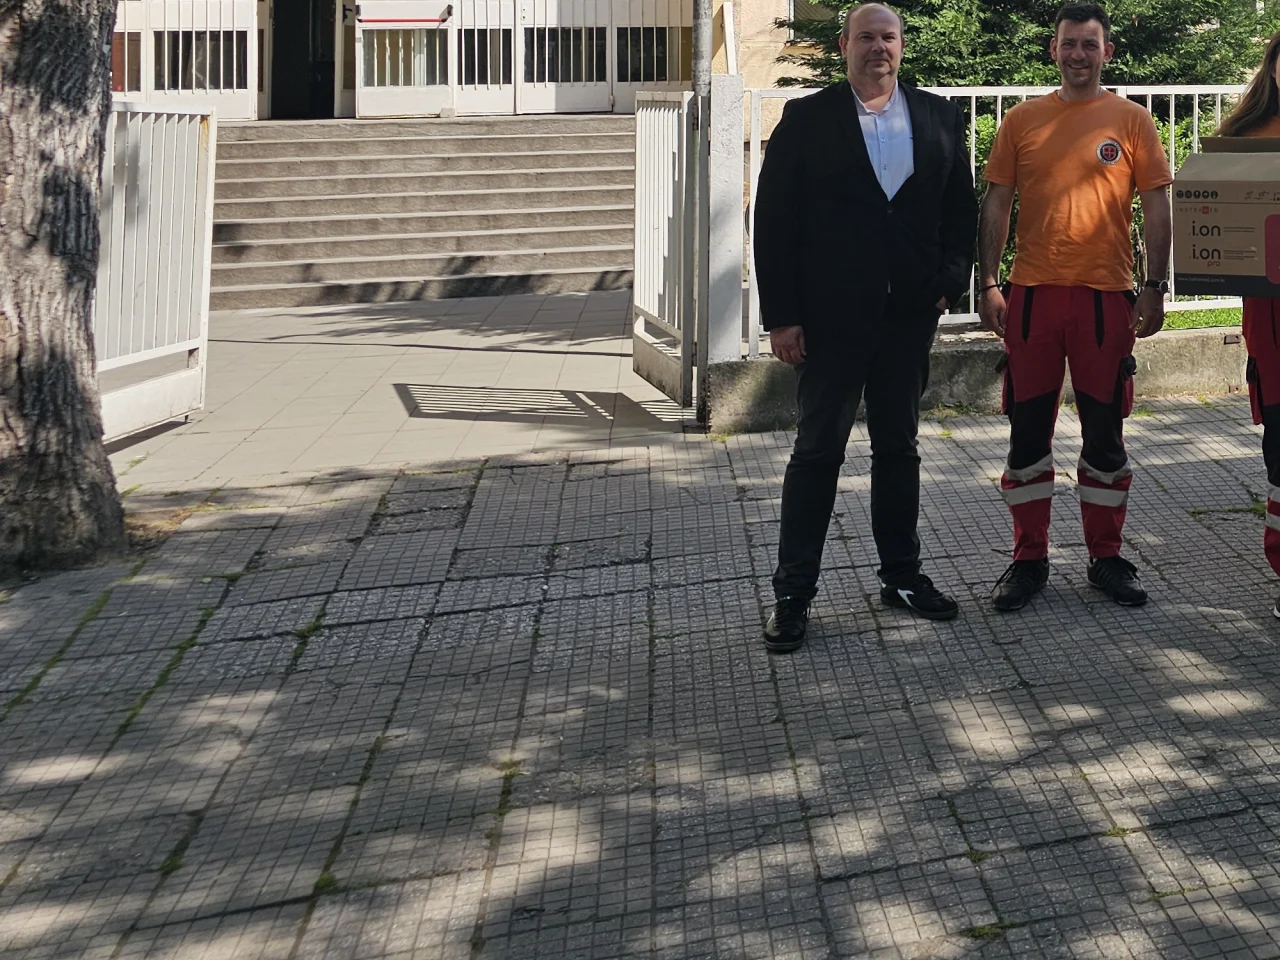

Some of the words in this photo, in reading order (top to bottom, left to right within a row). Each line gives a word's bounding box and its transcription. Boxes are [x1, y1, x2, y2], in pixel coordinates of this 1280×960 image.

[1191, 220, 1221, 237] i.on
[1192, 243, 1221, 260] i.on
[1207, 260, 1221, 268] pro
